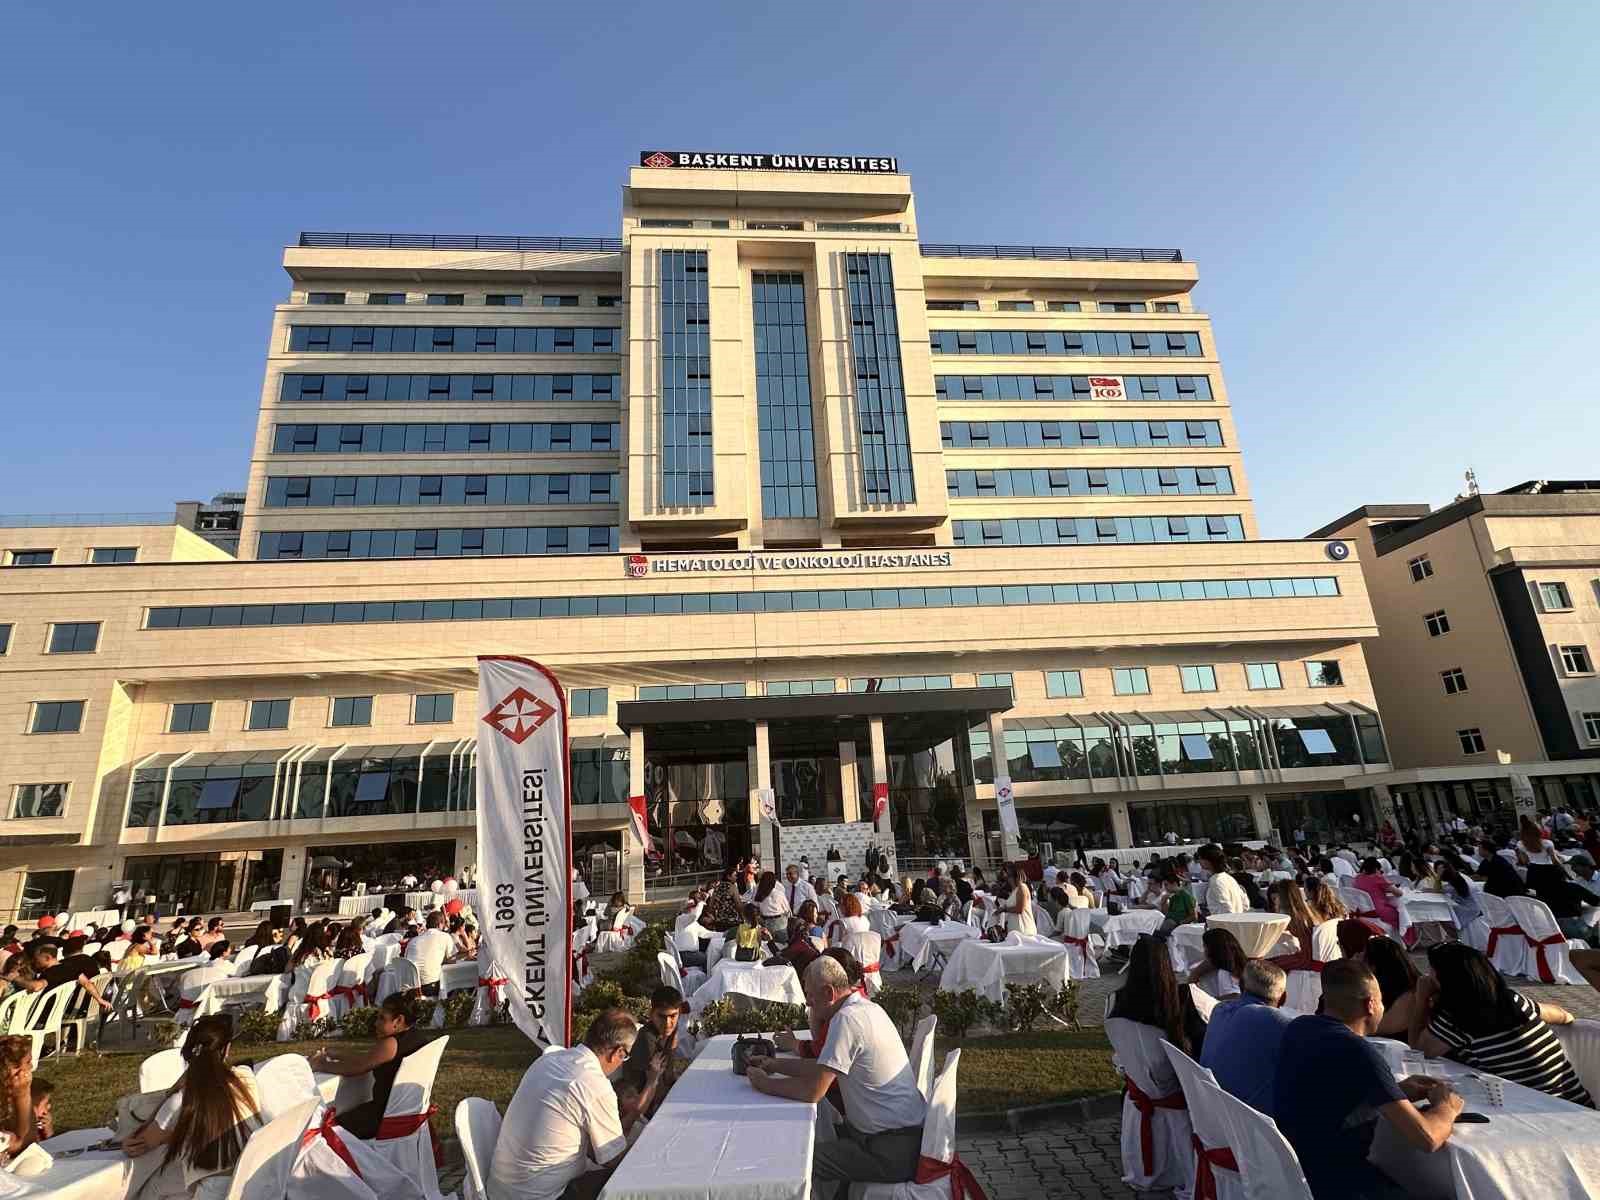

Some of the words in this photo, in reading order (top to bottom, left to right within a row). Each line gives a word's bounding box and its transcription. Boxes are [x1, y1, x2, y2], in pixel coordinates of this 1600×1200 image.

[679, 153, 764, 169] BAŞKENT
[771, 154, 896, 170] ÜNİVERSİTESİ
[654, 553, 758, 572] HEMATOLOJİ
[763, 558, 781, 570] VE
[784, 553, 865, 570] ONKOLOJİ
